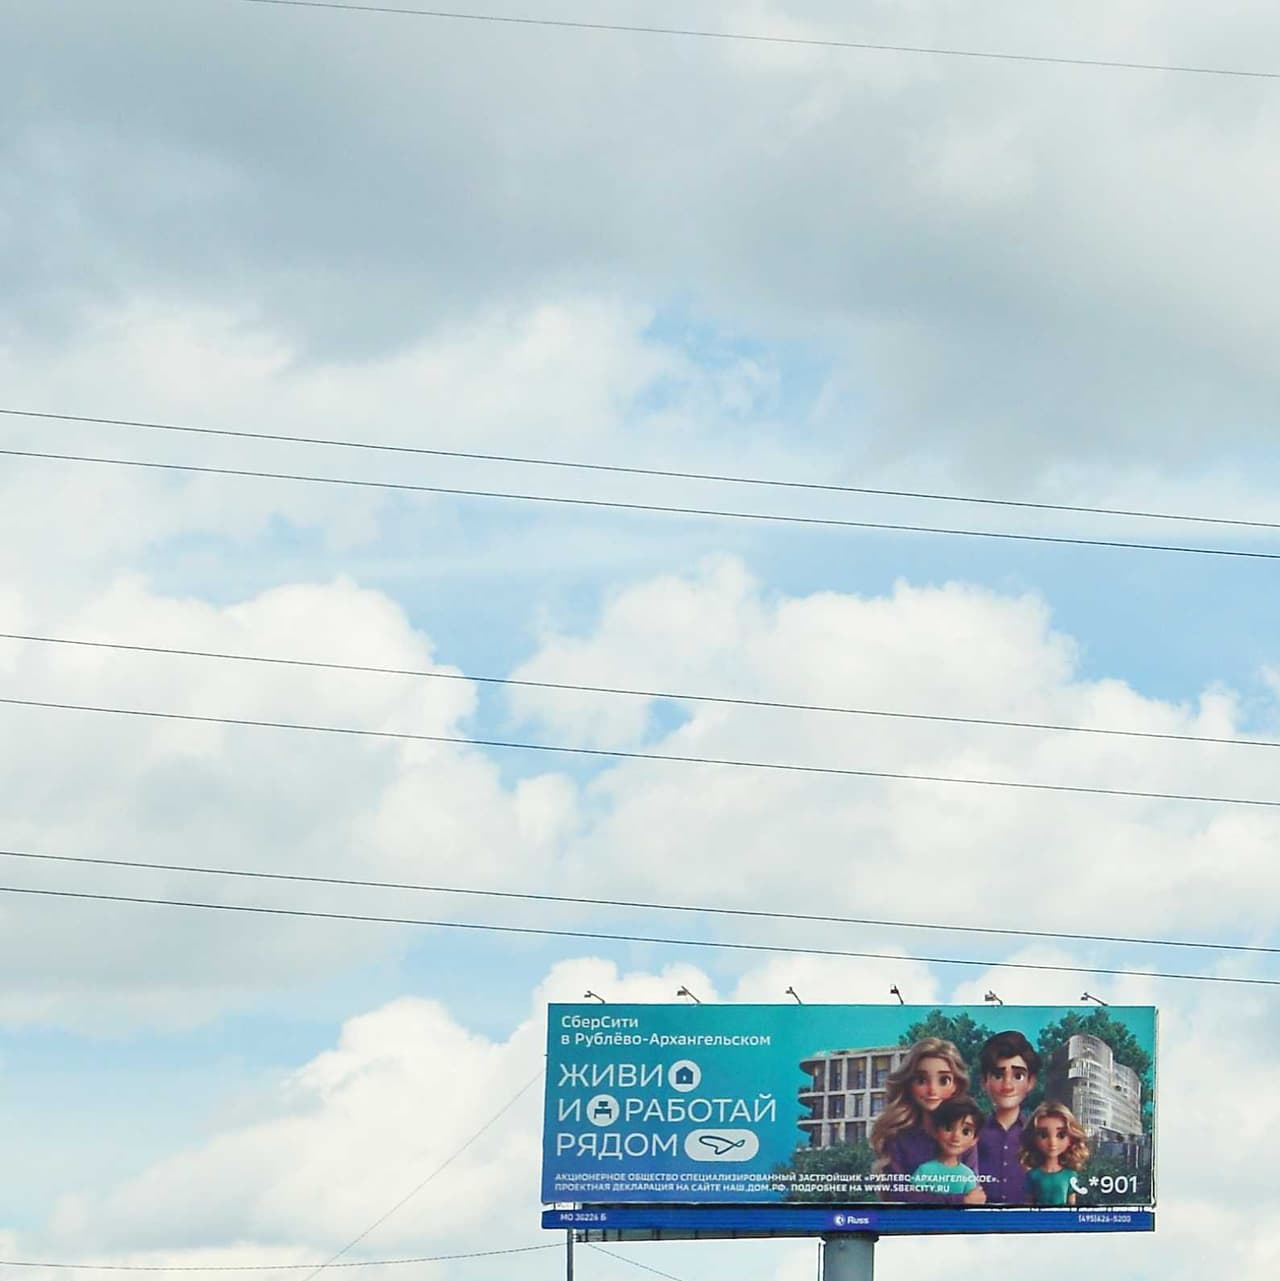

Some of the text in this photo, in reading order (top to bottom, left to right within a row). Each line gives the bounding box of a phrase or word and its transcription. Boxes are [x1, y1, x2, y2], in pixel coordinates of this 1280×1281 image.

[561, 1016, 638, 1029] СберСити
[561, 1033, 771, 1048] в Рублёво-Архангельском
[558, 1063, 663, 1087] ЖИВИ
[558, 1093, 776, 1122] И РАБОТАЙ
[556, 1132, 677, 1160] РЯДОМ
[555, 1173, 626, 1181] АКЦИОНЕРНОЕ
[627, 1173, 679, 1182] ОБЩЕСТВО
[681, 1172, 797, 1182] СПЕЦИАЛИЗИРОВАННЫЙ
[798, 1172, 862, 1182] ЗАСТРОЙЩИК
[554, 1183, 611, 1191] ПРОЕКТНАЯ
[612, 1183, 674, 1192] ДЕКЛАРАЦИЯ
[691, 1183, 721, 1192] САЙТЕ
[791, 1184, 848, 1192] ПОДРОБНЕЕ
[849, 1184, 862, 1192] НА
[847, 1215, 870, 1225] Russ
